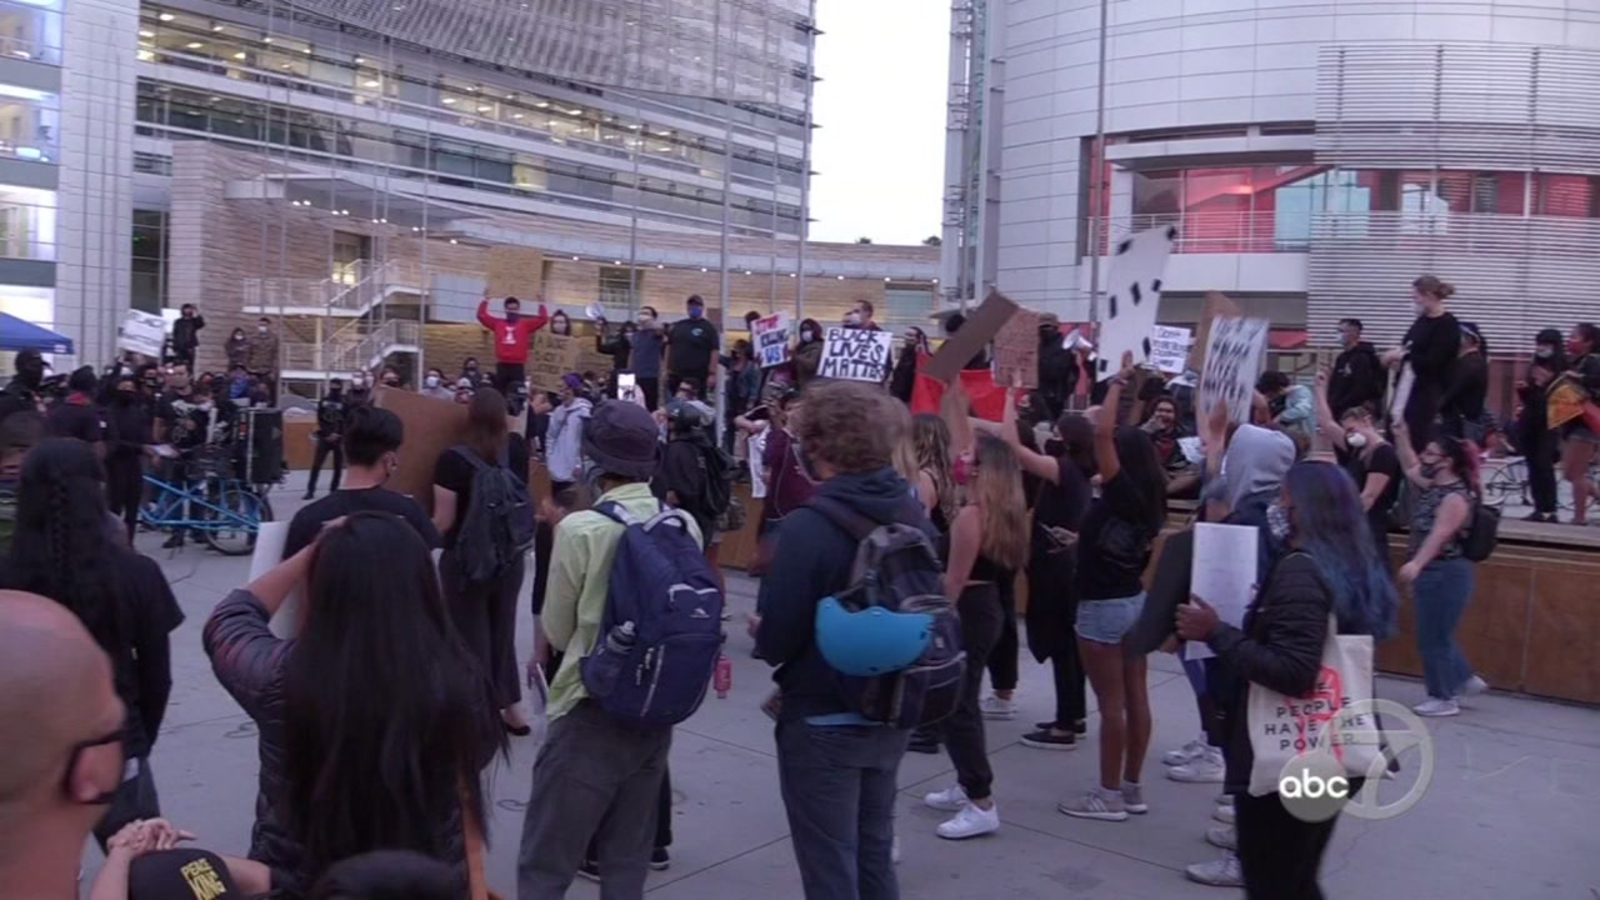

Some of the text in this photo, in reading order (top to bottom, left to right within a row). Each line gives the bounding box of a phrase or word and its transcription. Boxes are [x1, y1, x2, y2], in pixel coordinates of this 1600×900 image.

[828, 329, 878, 344] BLACK
[765, 345, 781, 363] US
[829, 341, 885, 363] LIVES
[821, 358, 884, 379] MATTER
[1276, 697, 1351, 718] PEOPLE
[1264, 719, 1318, 735] HAVE
